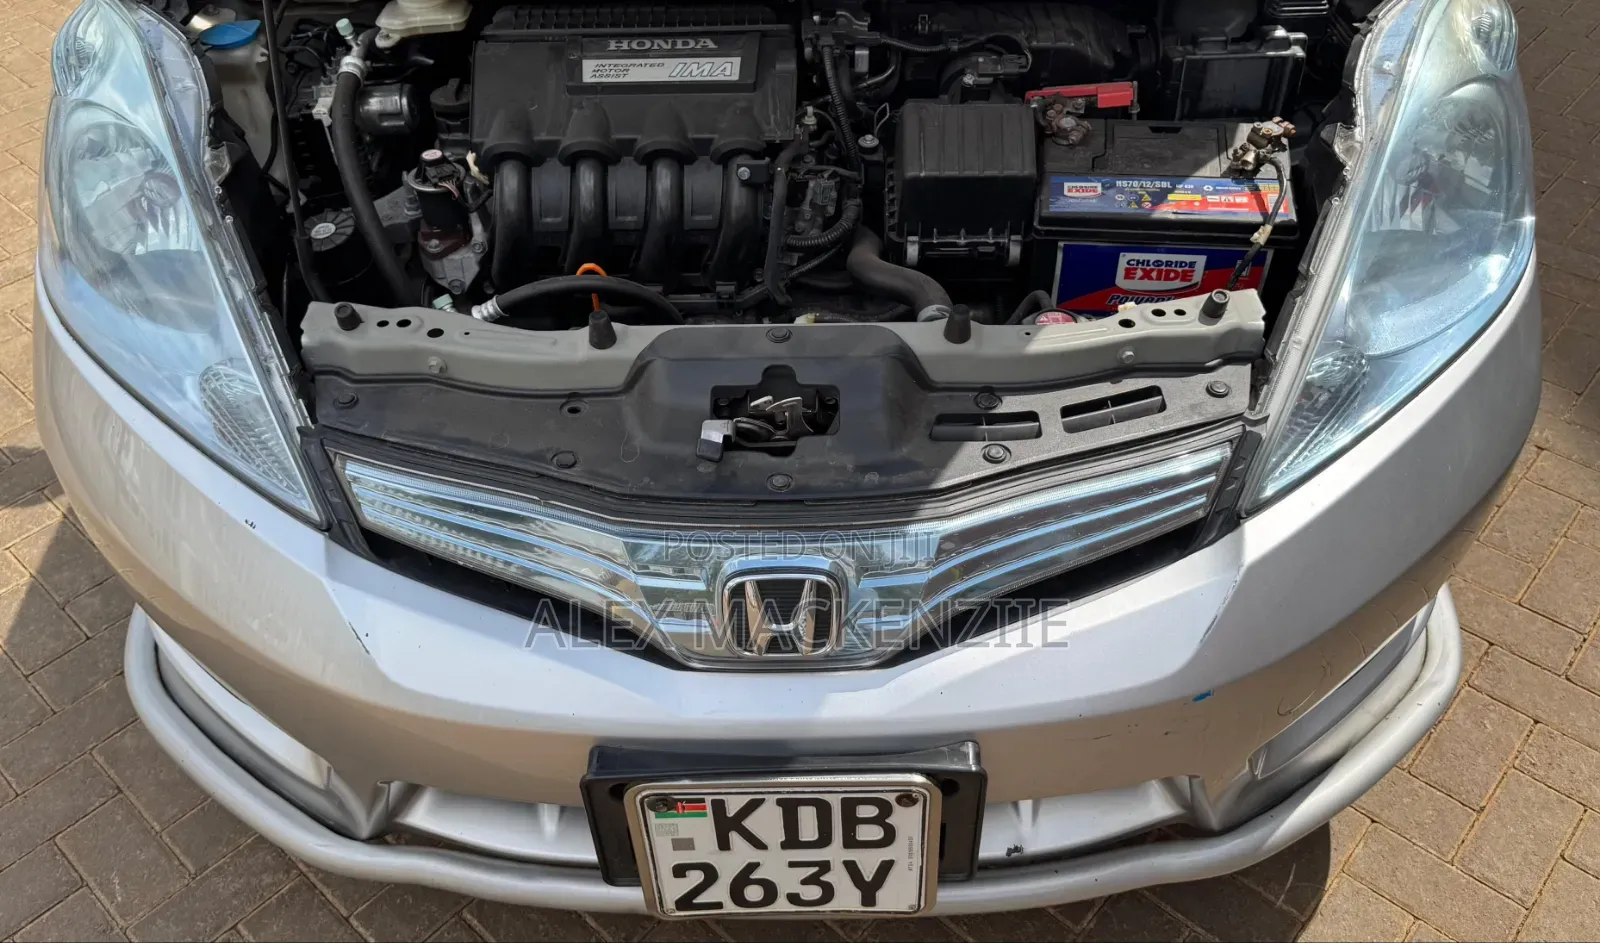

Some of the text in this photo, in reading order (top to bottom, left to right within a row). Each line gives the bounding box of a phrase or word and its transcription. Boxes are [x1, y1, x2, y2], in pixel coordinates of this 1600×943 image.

[606, 38, 718, 51] HONDA
[668, 61, 734, 78] IMA
[1126, 258, 1197, 269] CHLORIDE
[1124, 267, 1195, 282] EXIDE
[710, 796, 897, 851] KDB
[671, 858, 896, 911] 263Y
